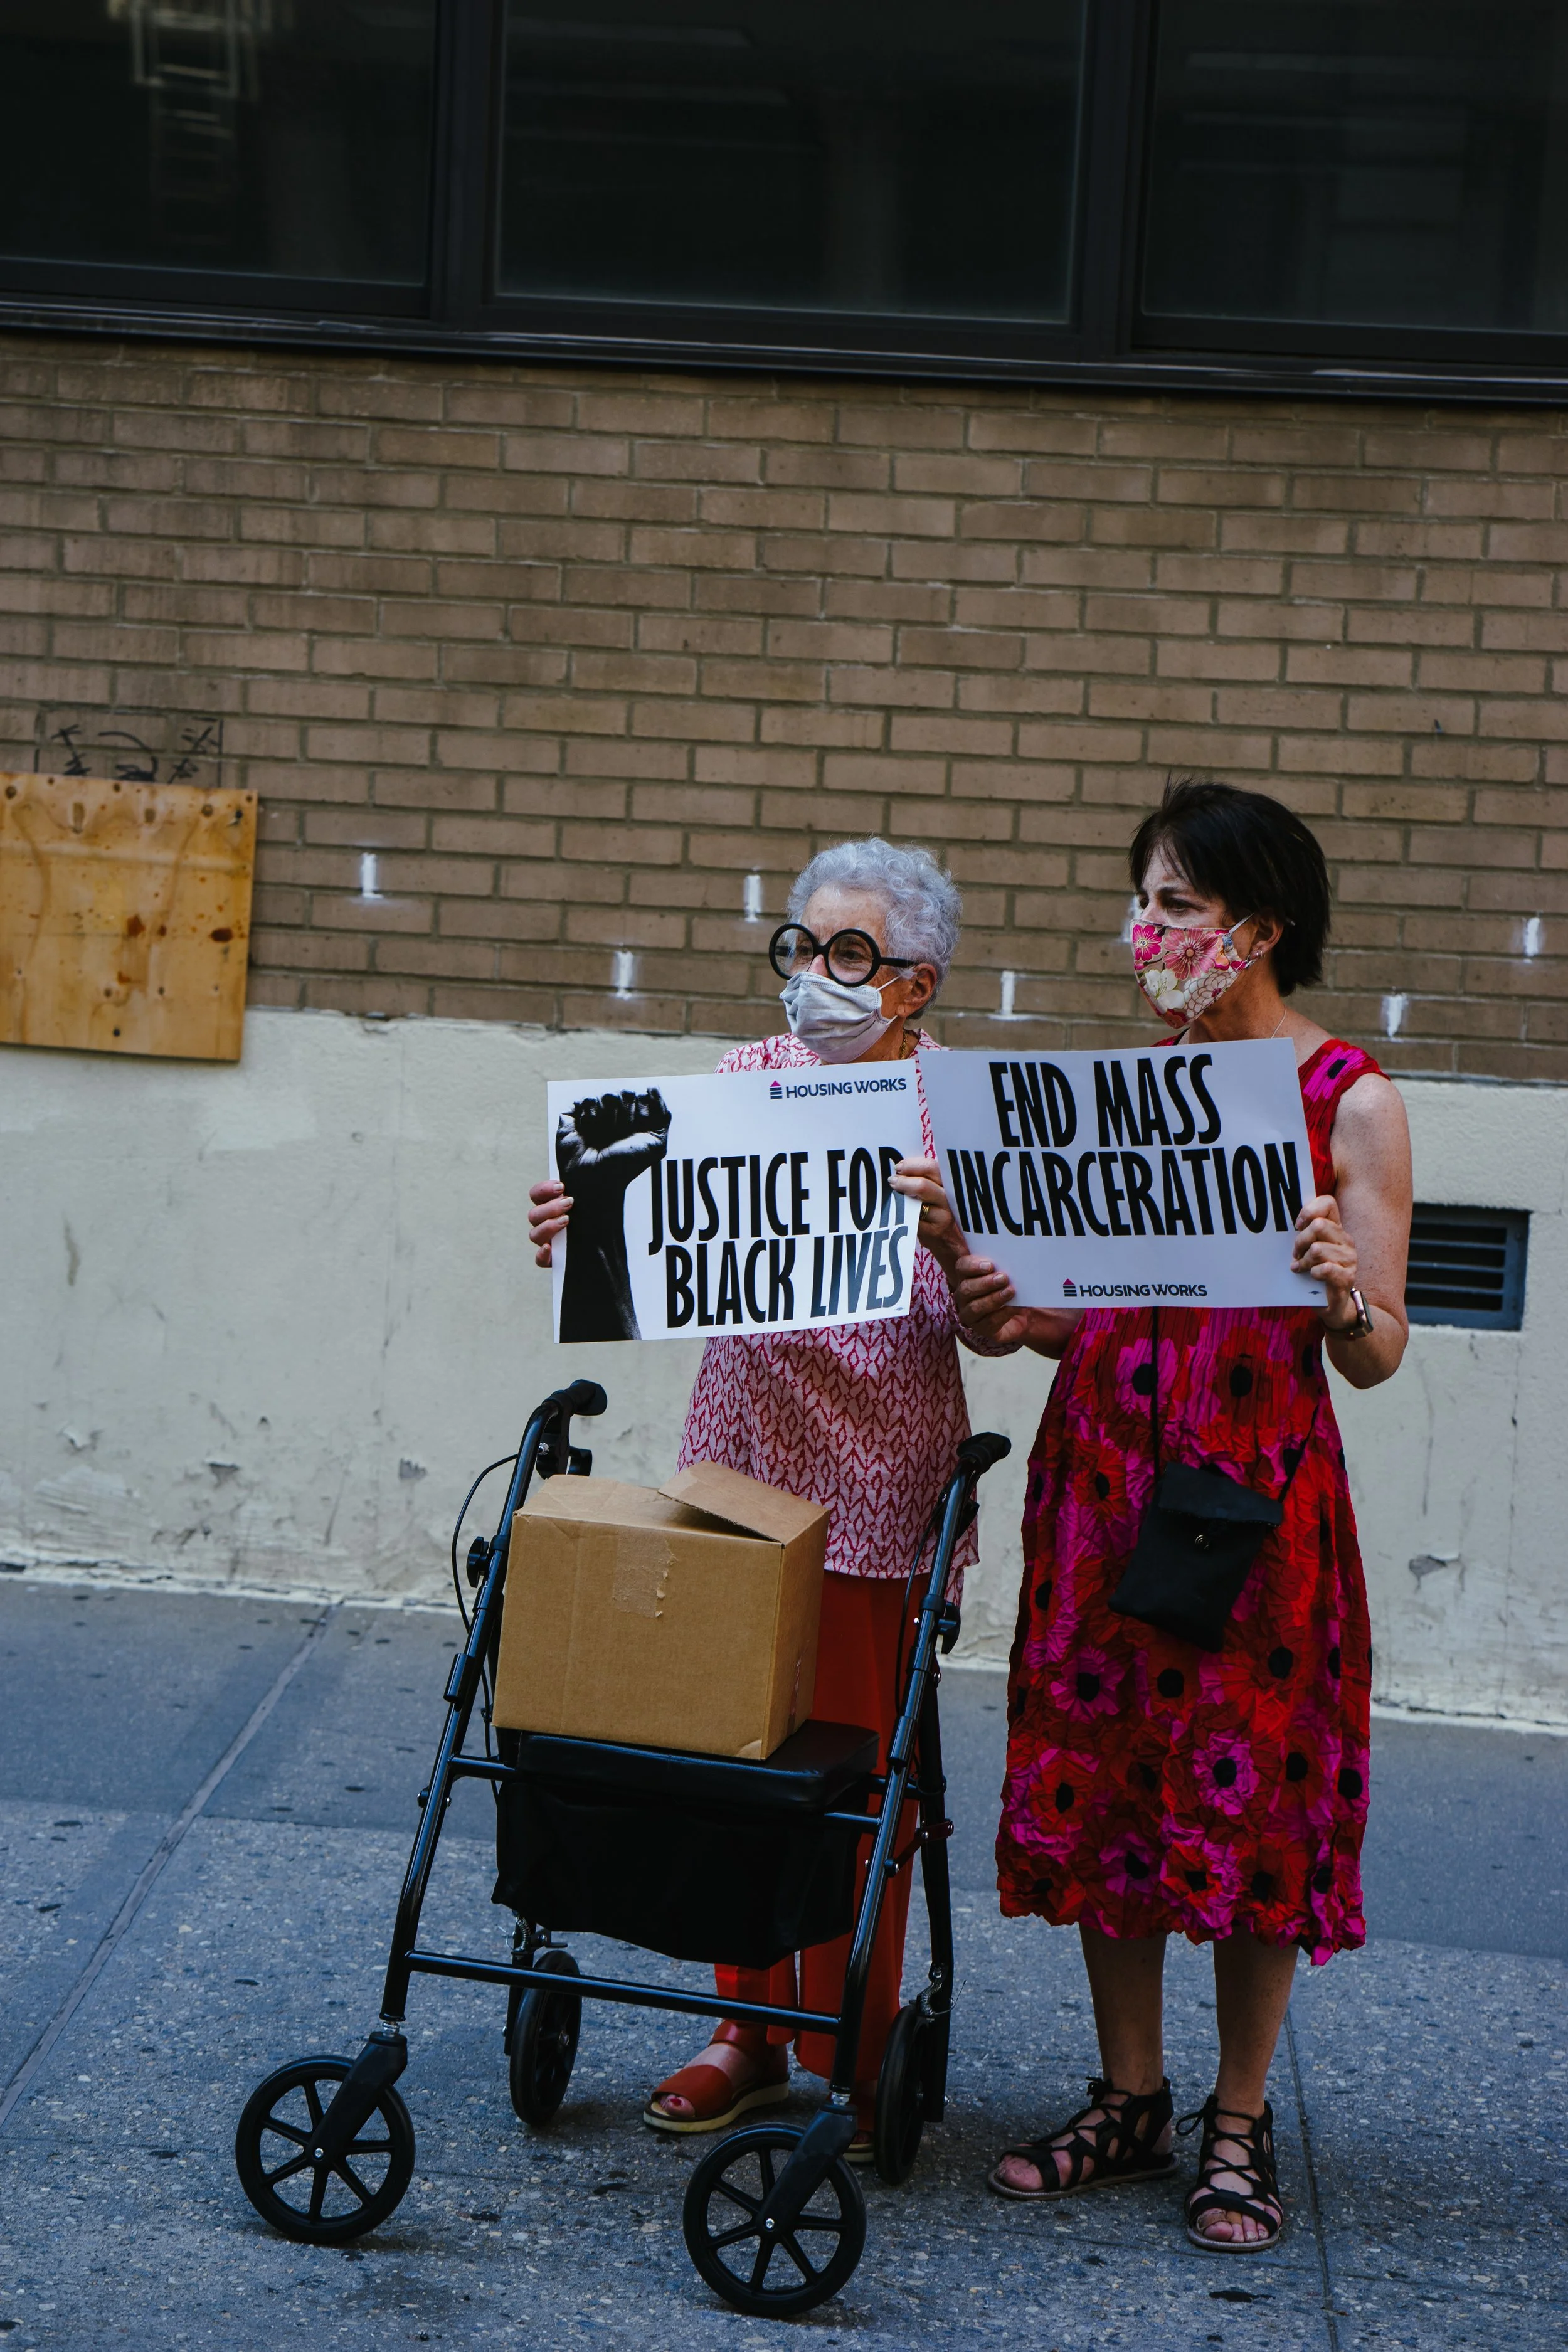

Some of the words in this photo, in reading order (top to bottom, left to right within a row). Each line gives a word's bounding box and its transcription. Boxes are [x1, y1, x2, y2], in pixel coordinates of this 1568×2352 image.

[786, 1082, 852, 1098] HOUSING
[854, 1078, 906, 1093] WORKS
[989, 1061, 1077, 1148] END
[1094, 1054, 1221, 1147] MASS
[649, 1152, 810, 1256] JUSTICE
[827, 1147, 905, 1233] FOR
[946, 1142, 1303, 1236] INCARCERATION
[665, 1238, 796, 1328] BLACK
[810, 1226, 908, 1318] LIVES
[1079, 1285, 1150, 1297] HOUSING
[1152, 1284, 1207, 1296] WORKS
